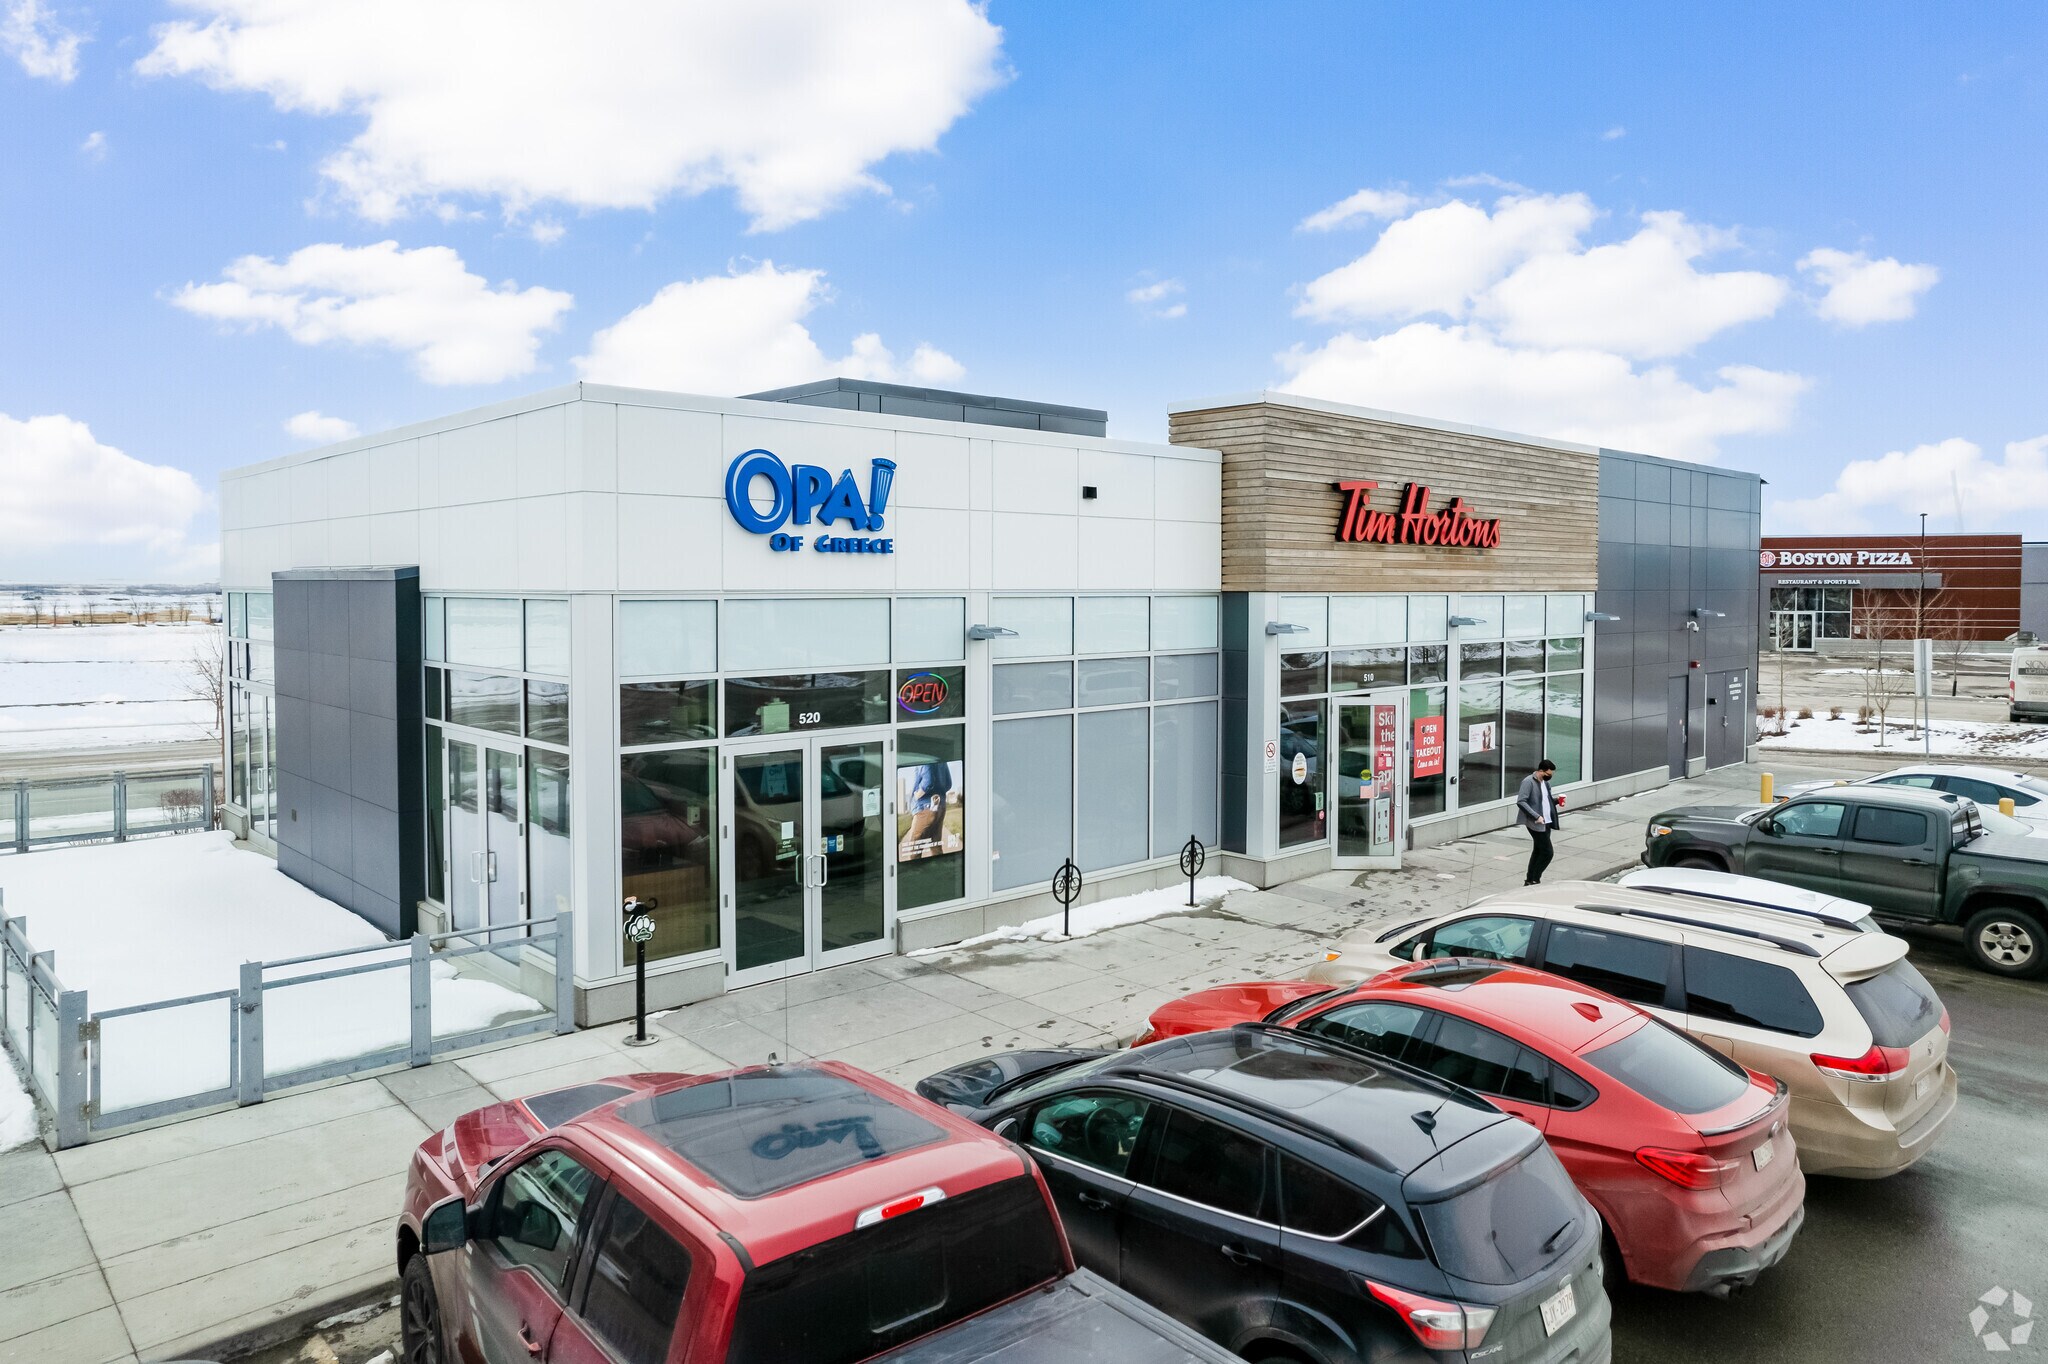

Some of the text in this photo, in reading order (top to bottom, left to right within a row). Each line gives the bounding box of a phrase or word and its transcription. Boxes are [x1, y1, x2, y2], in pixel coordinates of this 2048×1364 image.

[725, 448, 897, 533] OPA!
[1333, 481, 1500, 548] Tim Hortons
[769, 532, 894, 554] OF GREECE
[1779, 551, 1913, 566] BOSTON PIZZA
[1363, 673, 1375, 682] 510
[901, 682, 946, 704] OPEN
[799, 712, 821, 725] 520
[1423, 736, 1435, 745] FOR
[1416, 746, 1441, 757] TAKEOUT
[1378, 769, 1394, 786] ap
